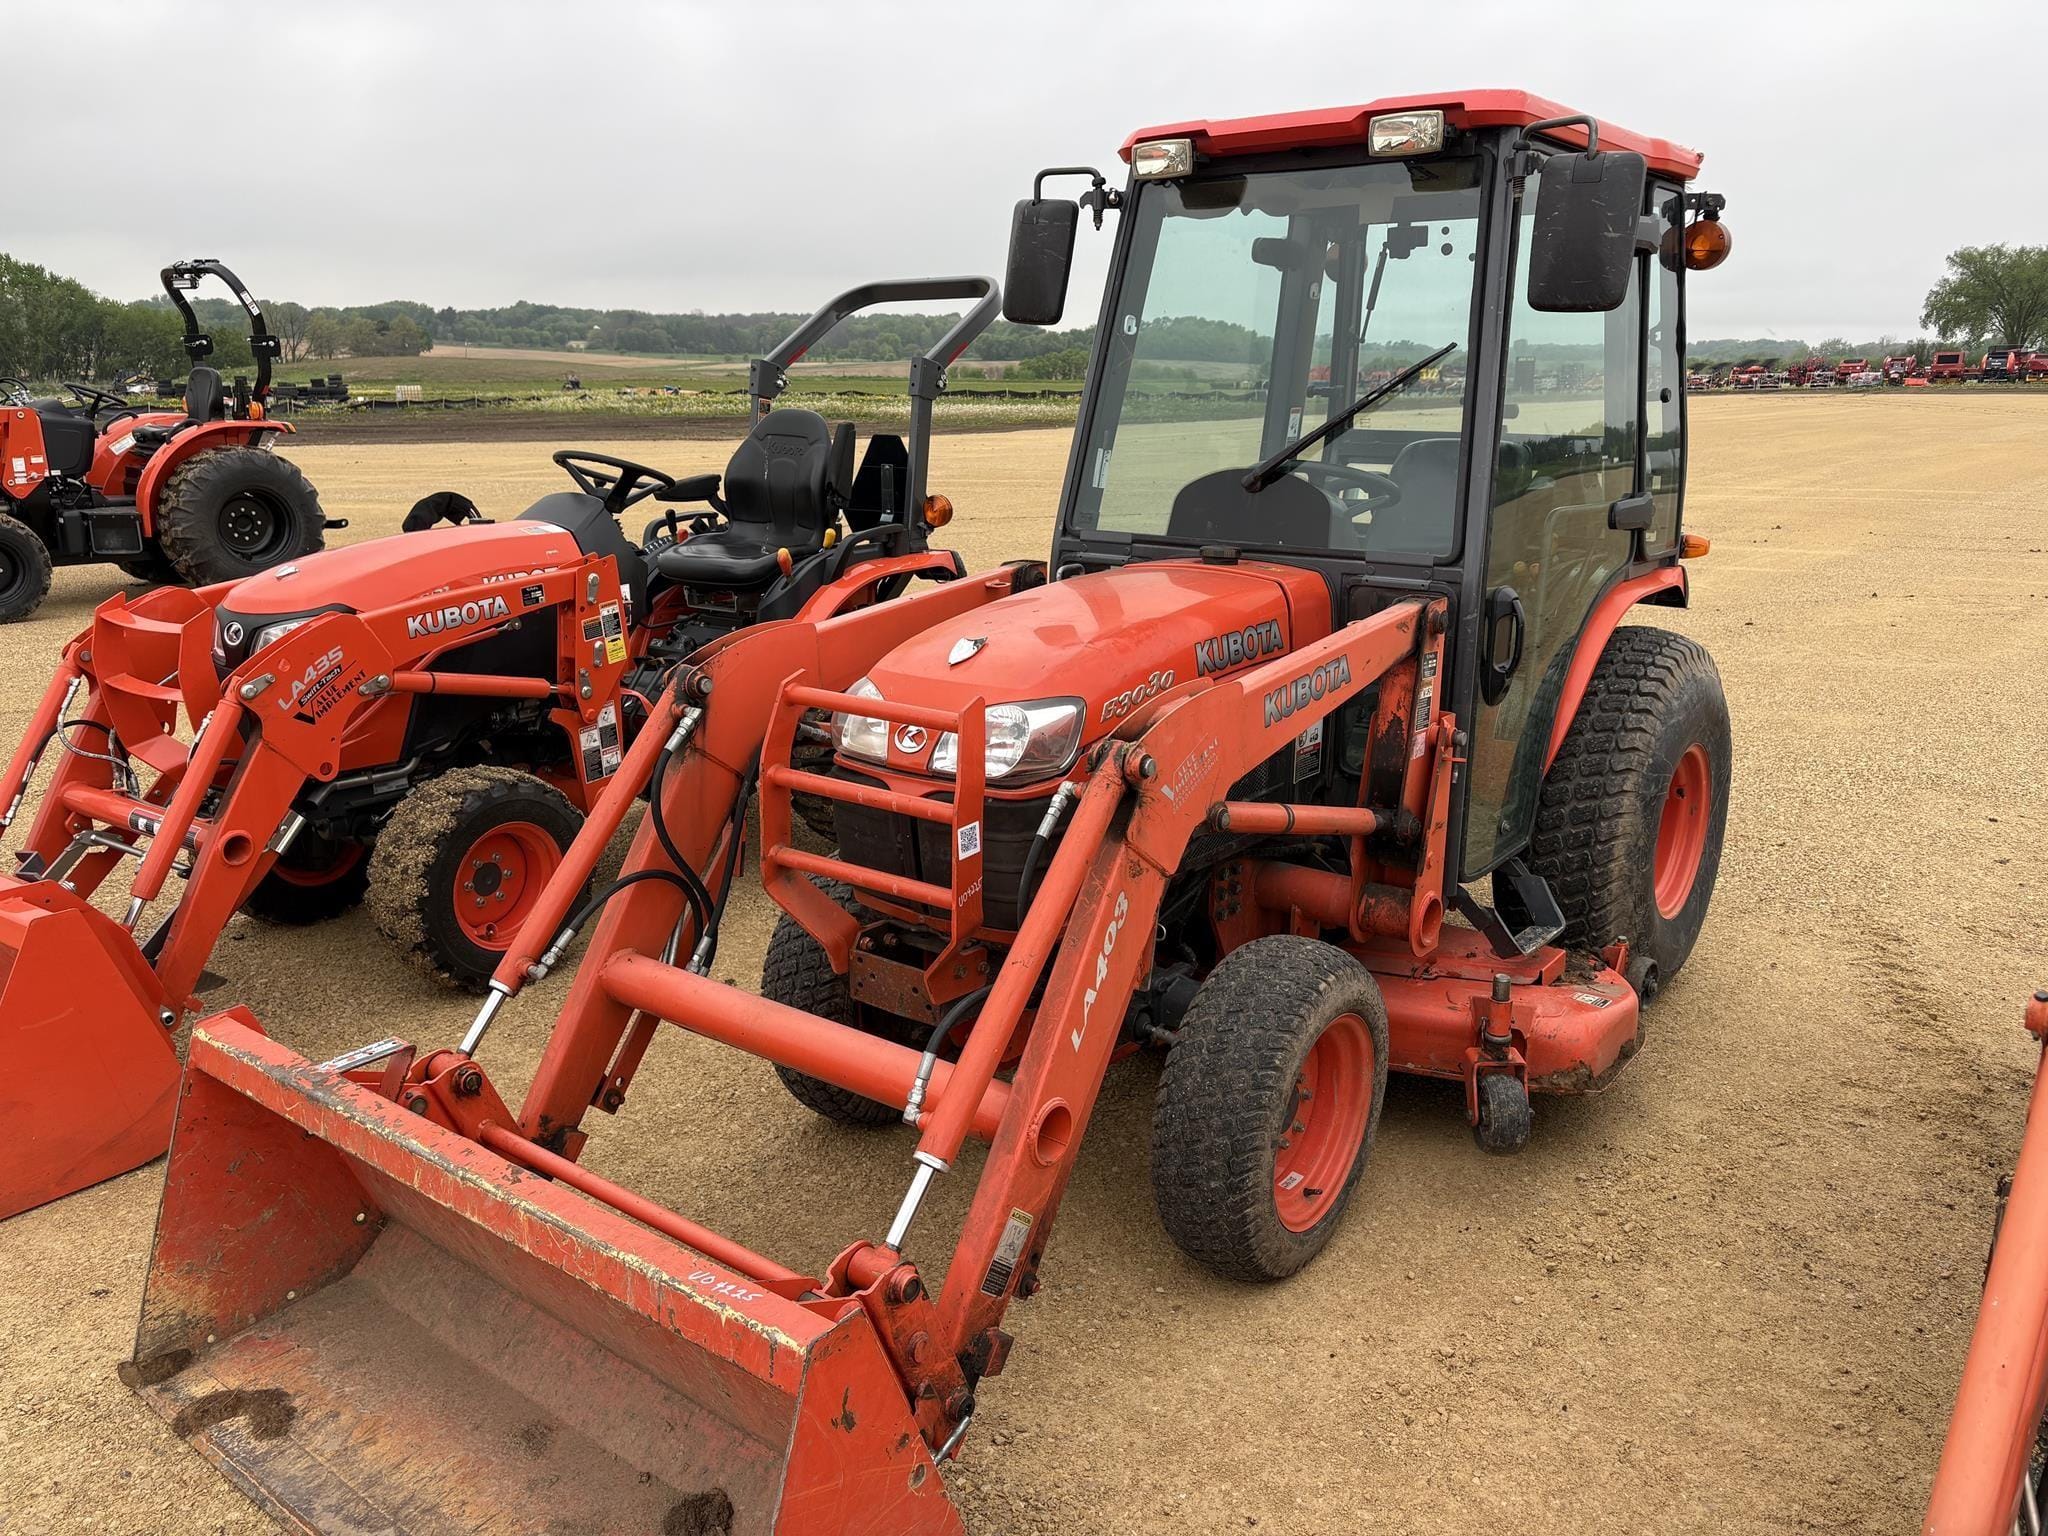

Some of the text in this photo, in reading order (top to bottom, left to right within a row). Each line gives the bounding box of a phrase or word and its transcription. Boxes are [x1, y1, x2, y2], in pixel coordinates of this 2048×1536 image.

[406, 595, 511, 639] KUBOTA
[1194, 619, 1284, 677] KUBOTA
[278, 645, 344, 711] LA435
[300, 667, 341, 706] Swift-Tach
[315, 670, 367, 719] IMPLEMENT
[1100, 669, 1175, 724] B3030
[1263, 654, 1352, 728] KUBOTA
[1071, 891, 1129, 1053] LA403
